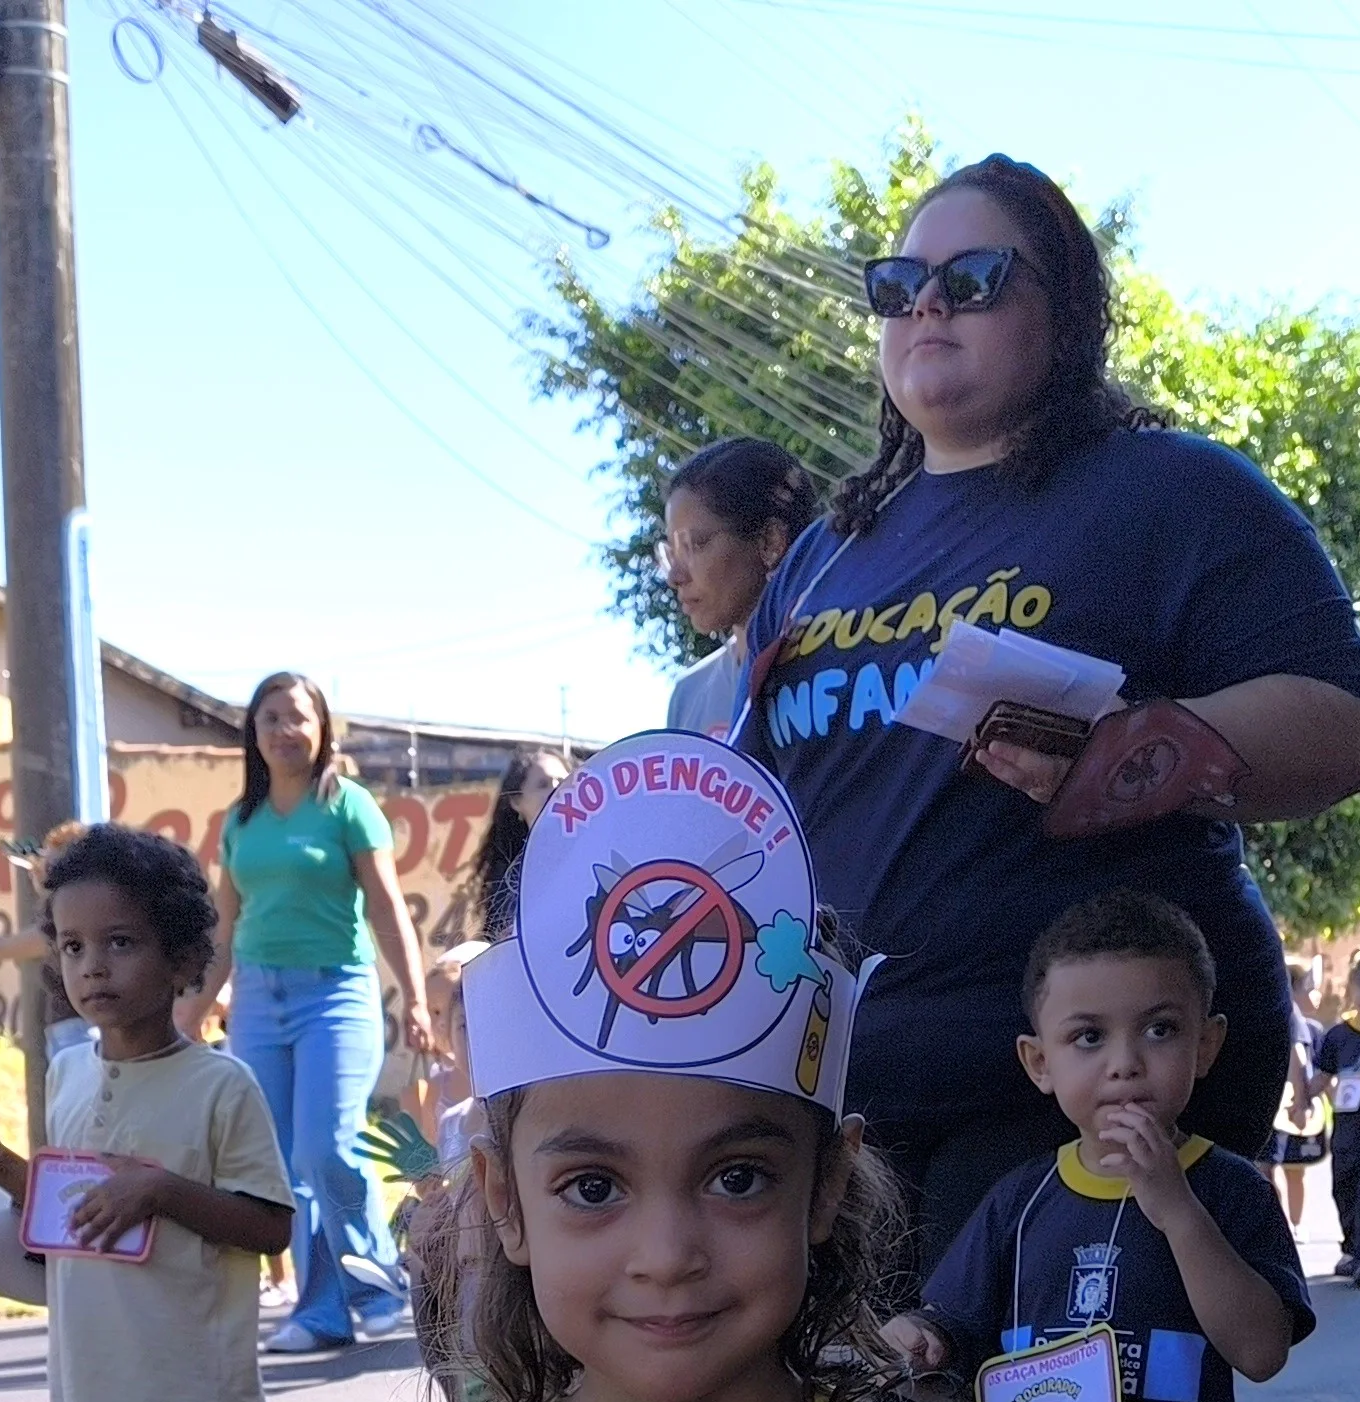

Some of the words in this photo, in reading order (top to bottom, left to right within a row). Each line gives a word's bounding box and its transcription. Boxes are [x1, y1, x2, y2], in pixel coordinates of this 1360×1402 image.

[767, 652, 944, 748] INFAN
[551, 771, 604, 833] XÔ
[1004, 1364, 1037, 1383] CAÇA
[1040, 1343, 1098, 1373] MOSQUITOS
